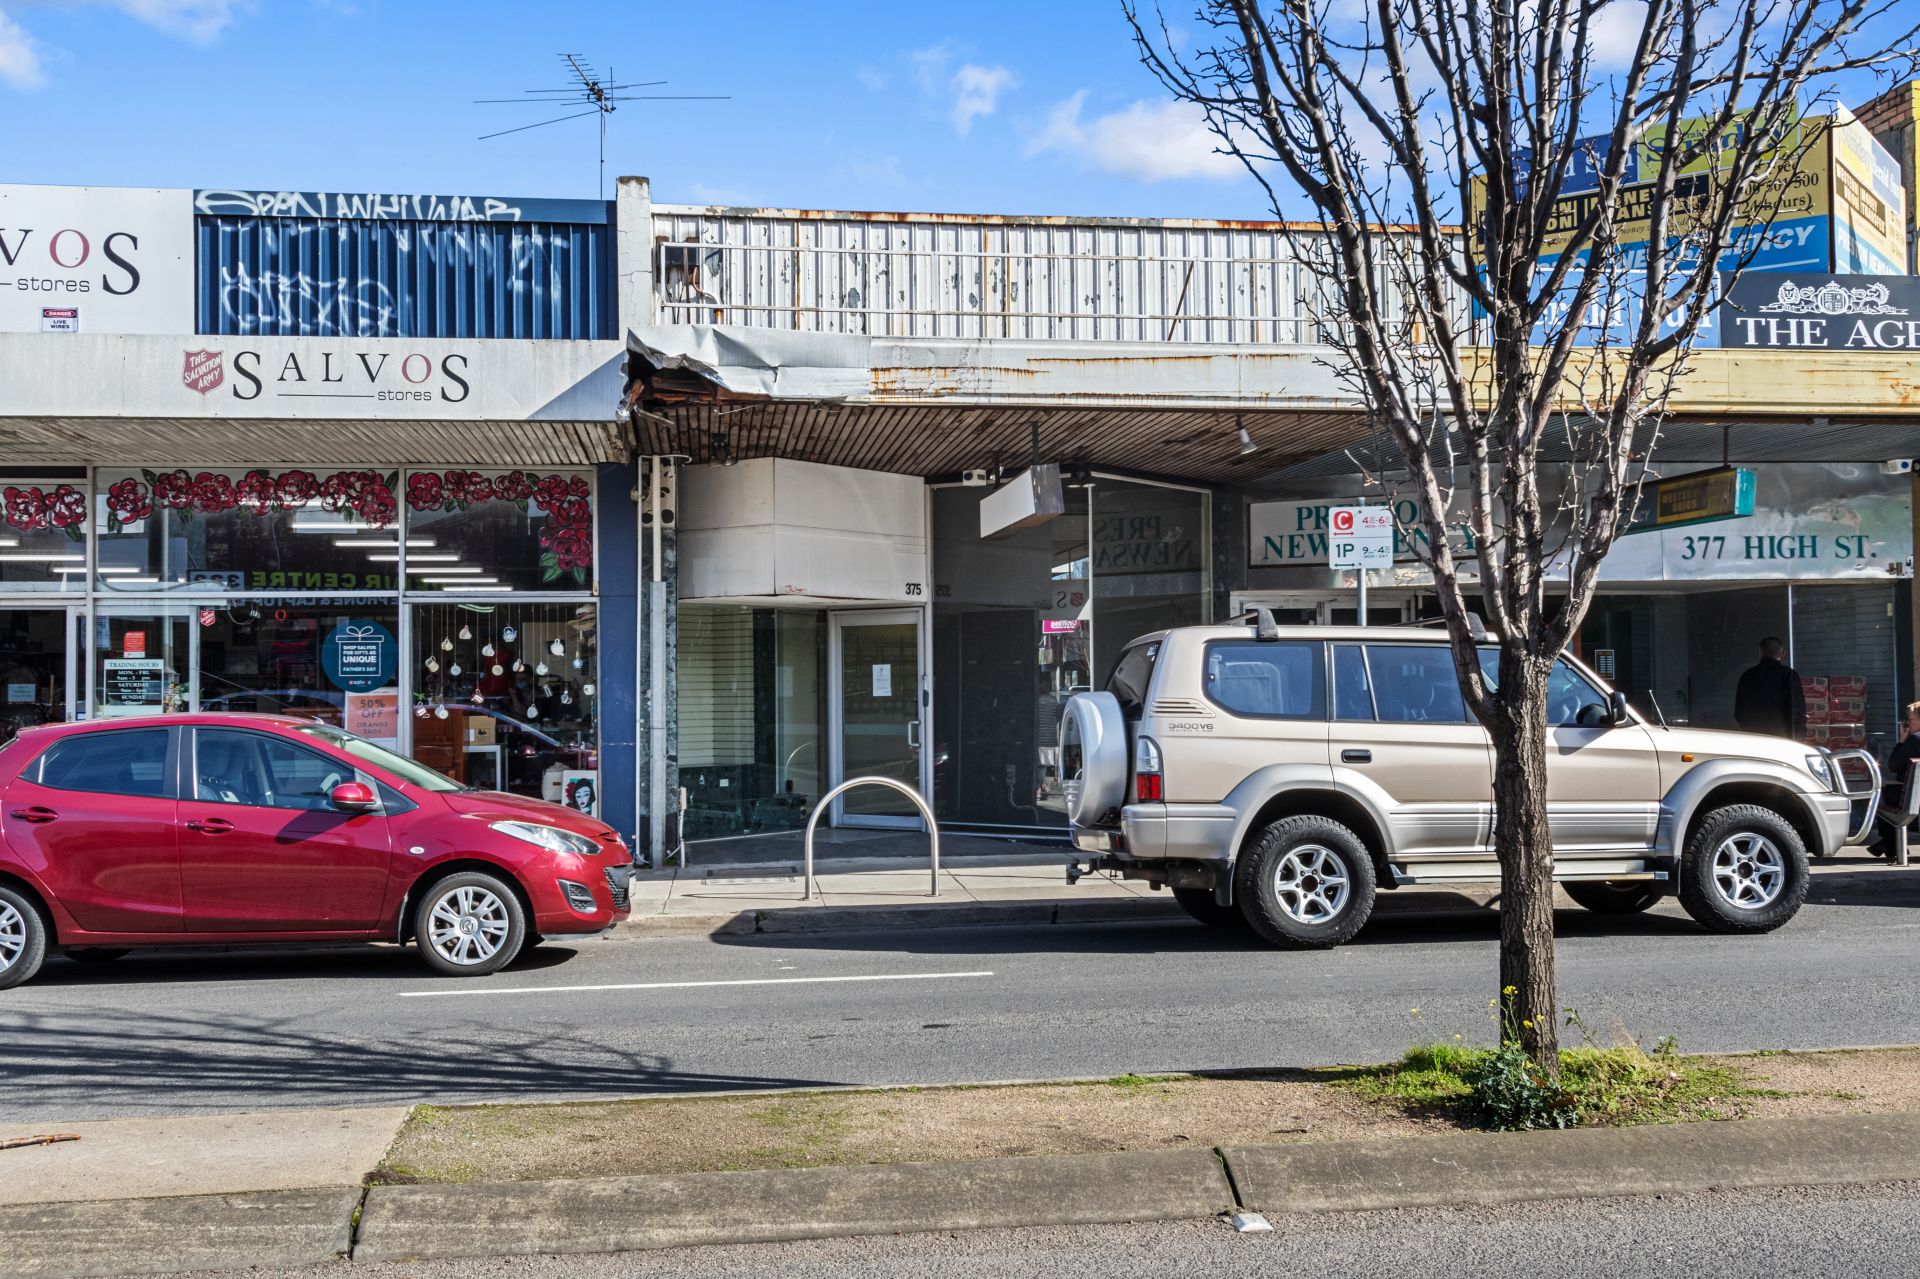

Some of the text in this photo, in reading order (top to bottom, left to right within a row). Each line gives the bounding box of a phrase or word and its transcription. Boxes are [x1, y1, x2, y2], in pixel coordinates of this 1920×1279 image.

[17, 276, 90, 292] stores
[1736, 317, 1828, 347] THE
[189, 350, 207, 367] THE
[184, 355, 221, 384] SALVATION
[232, 351, 470, 402] SALVOS
[197, 367, 220, 389] ARMY
[377, 389, 432, 401] stores
[1335, 543, 1355, 558] 1P
[1681, 535, 1877, 560] 377 HIGH ST.
[905, 583, 922, 596] 375
[342, 655, 377, 663] UNIQUE
[360, 699, 385, 709] 50%
[361, 709, 384, 719] OFF
